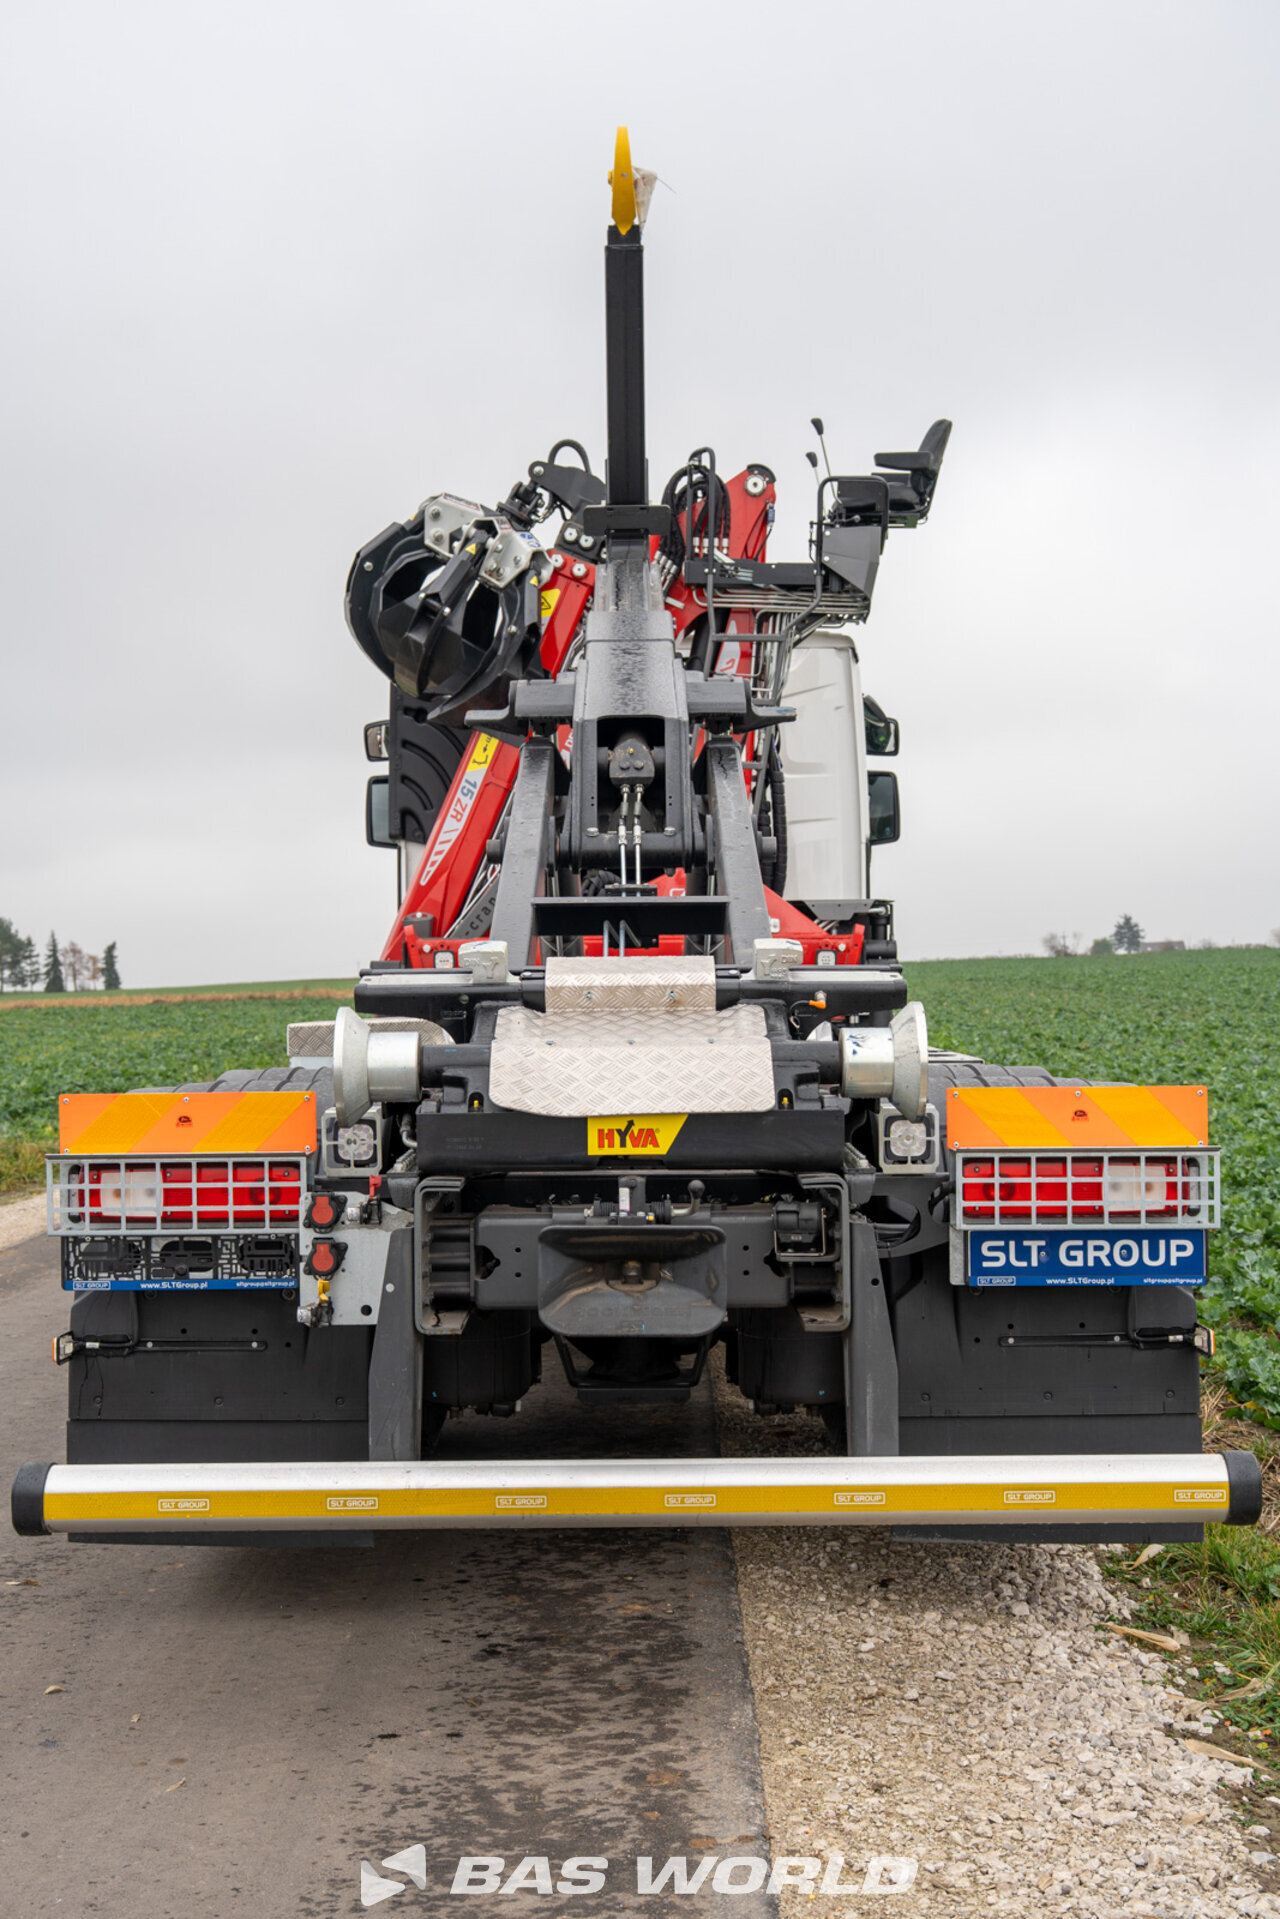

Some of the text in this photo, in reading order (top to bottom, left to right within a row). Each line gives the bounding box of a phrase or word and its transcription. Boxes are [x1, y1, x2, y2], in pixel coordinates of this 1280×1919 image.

[449, 777, 478, 822] 15 ZR
[597, 1120, 660, 1148] HYVA
[981, 1239, 1194, 1267] SLT GROUP
[1046, 1277, 1115, 1285] www.SLTGroup.pl
[140, 1281, 208, 1290] www.SLTGroup.pl
[684, 1496, 712, 1504] GROUP
[1008, 1493, 1021, 1501] SLT
[162, 1501, 175, 1509] SLT
[346, 1499, 374, 1507] GROUP
[499, 1498, 543, 1506] SLT GROUP
